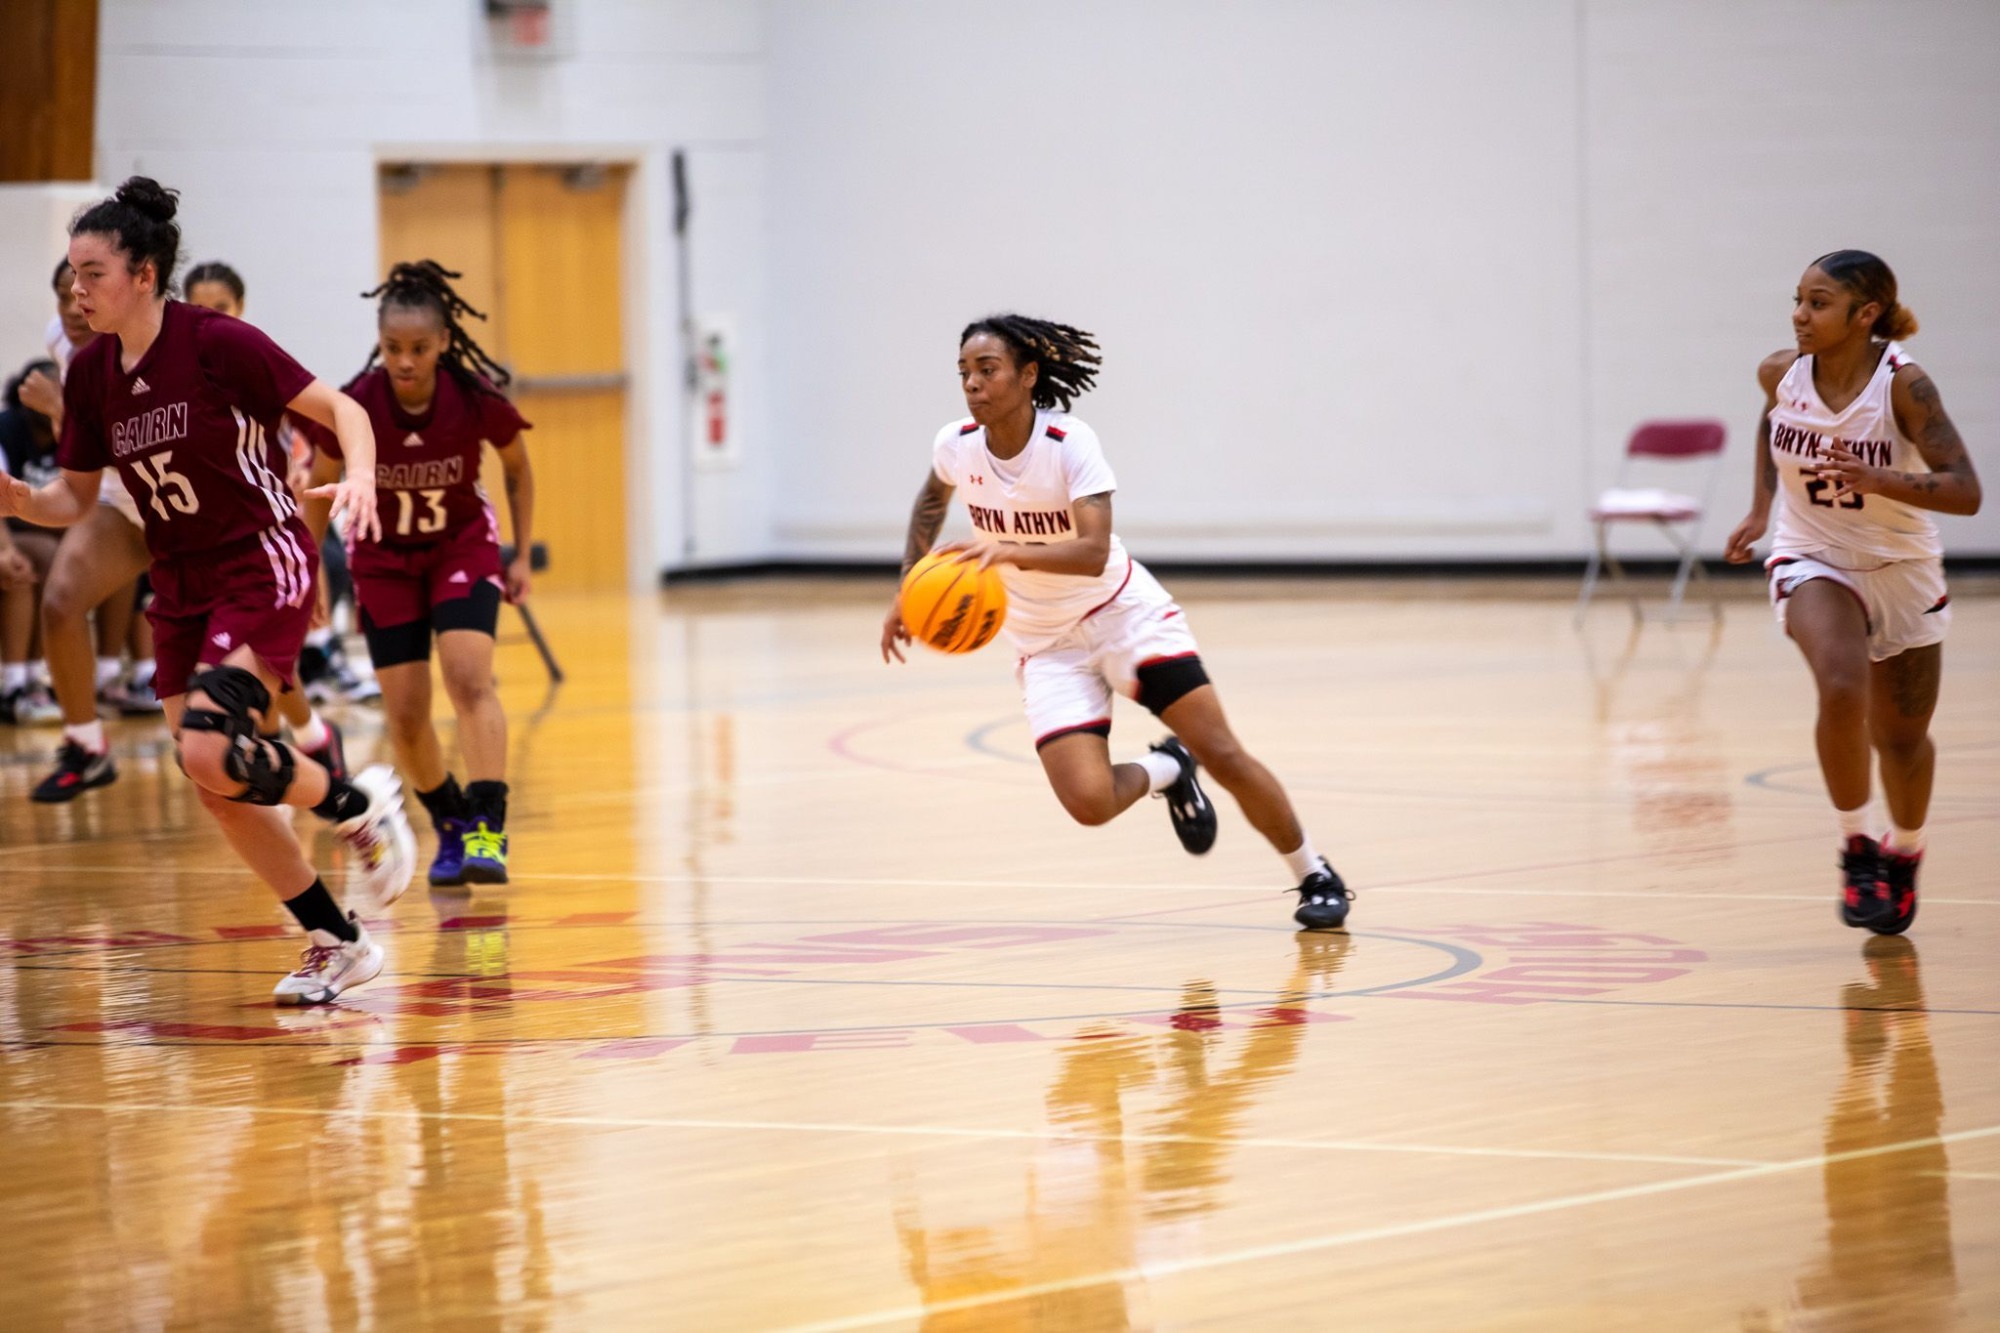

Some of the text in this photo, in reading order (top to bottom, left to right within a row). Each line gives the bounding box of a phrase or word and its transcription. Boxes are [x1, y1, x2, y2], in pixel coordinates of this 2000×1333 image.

[110, 401, 188, 457] CAIRN
[1773, 423, 1892, 467] BRYN HYN
[129, 450, 200, 521] 15
[376, 455, 463, 489] CAIRN
[394, 489, 447, 535] 13
[968, 503, 1071, 534] BRYN ATHYN
